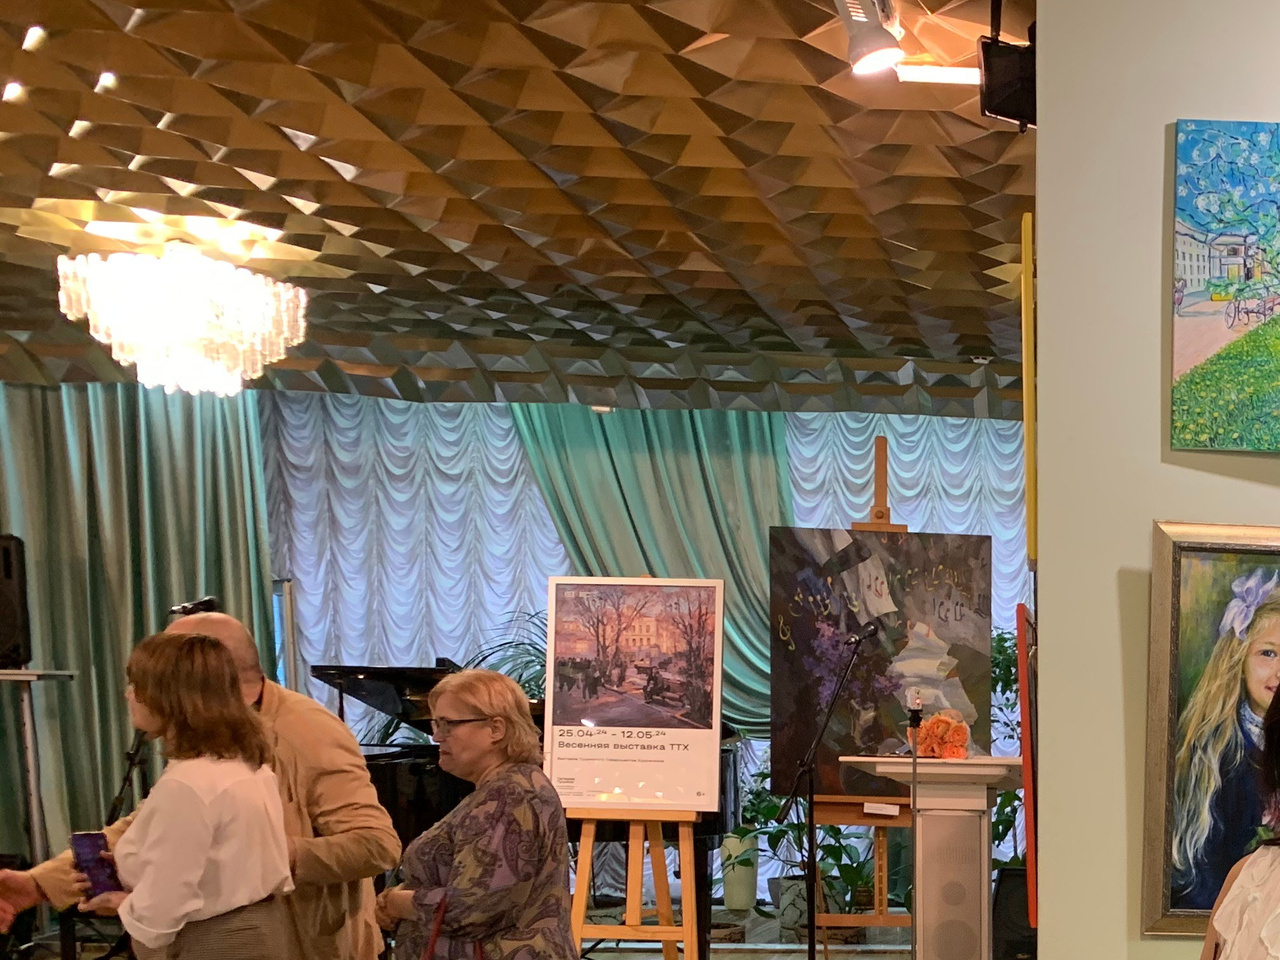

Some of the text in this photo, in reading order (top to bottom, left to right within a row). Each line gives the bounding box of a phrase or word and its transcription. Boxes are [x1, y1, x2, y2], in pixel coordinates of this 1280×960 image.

[558, 741, 690, 751] Весенняя выставка ТТХ
